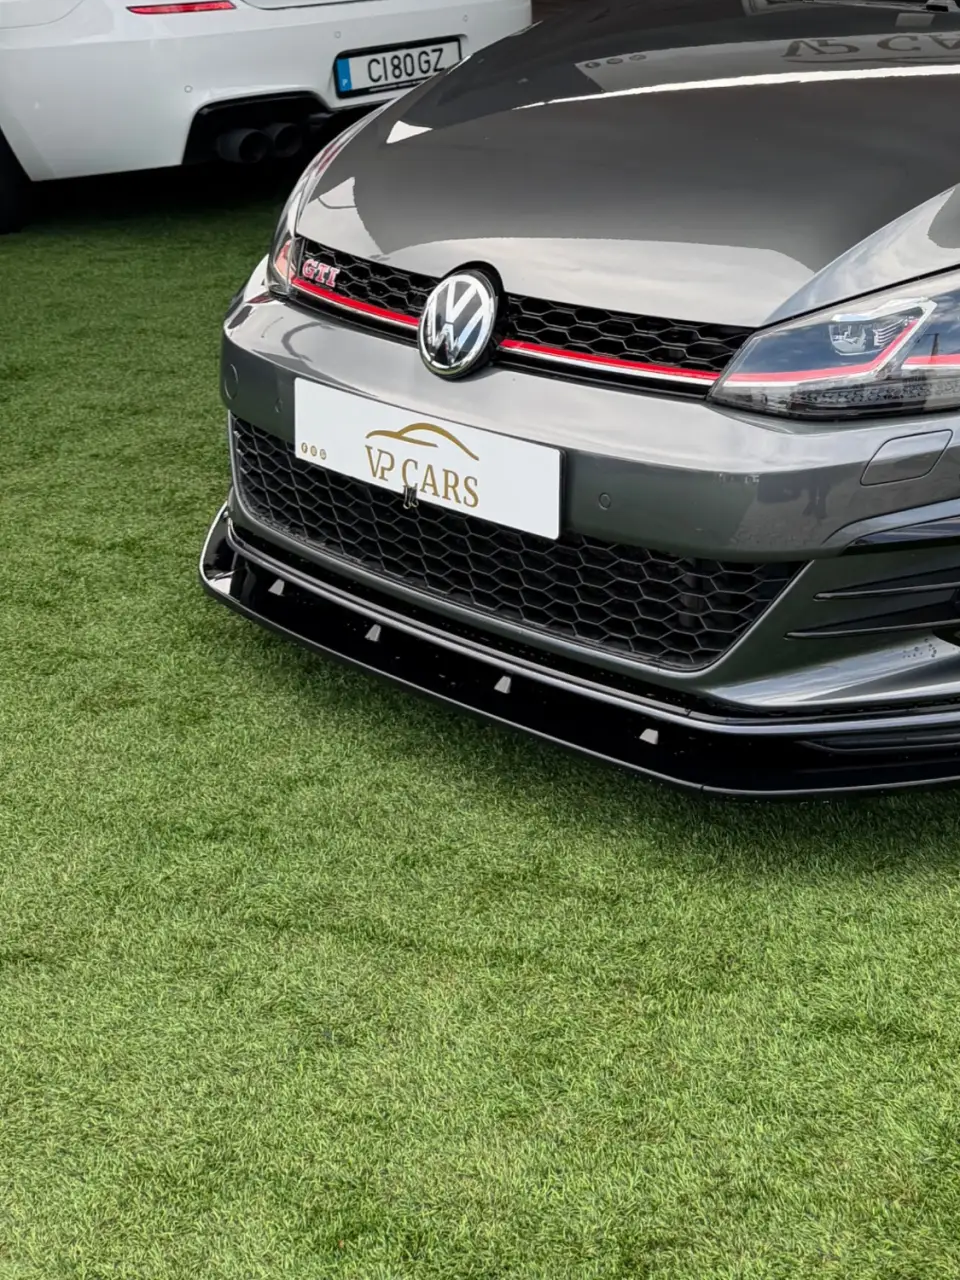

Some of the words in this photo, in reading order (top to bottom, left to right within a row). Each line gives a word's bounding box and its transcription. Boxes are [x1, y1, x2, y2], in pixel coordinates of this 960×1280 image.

[302, 259, 340, 288] GTI
[364, 444, 396, 482] VP
[401, 458, 479, 508] CARS
